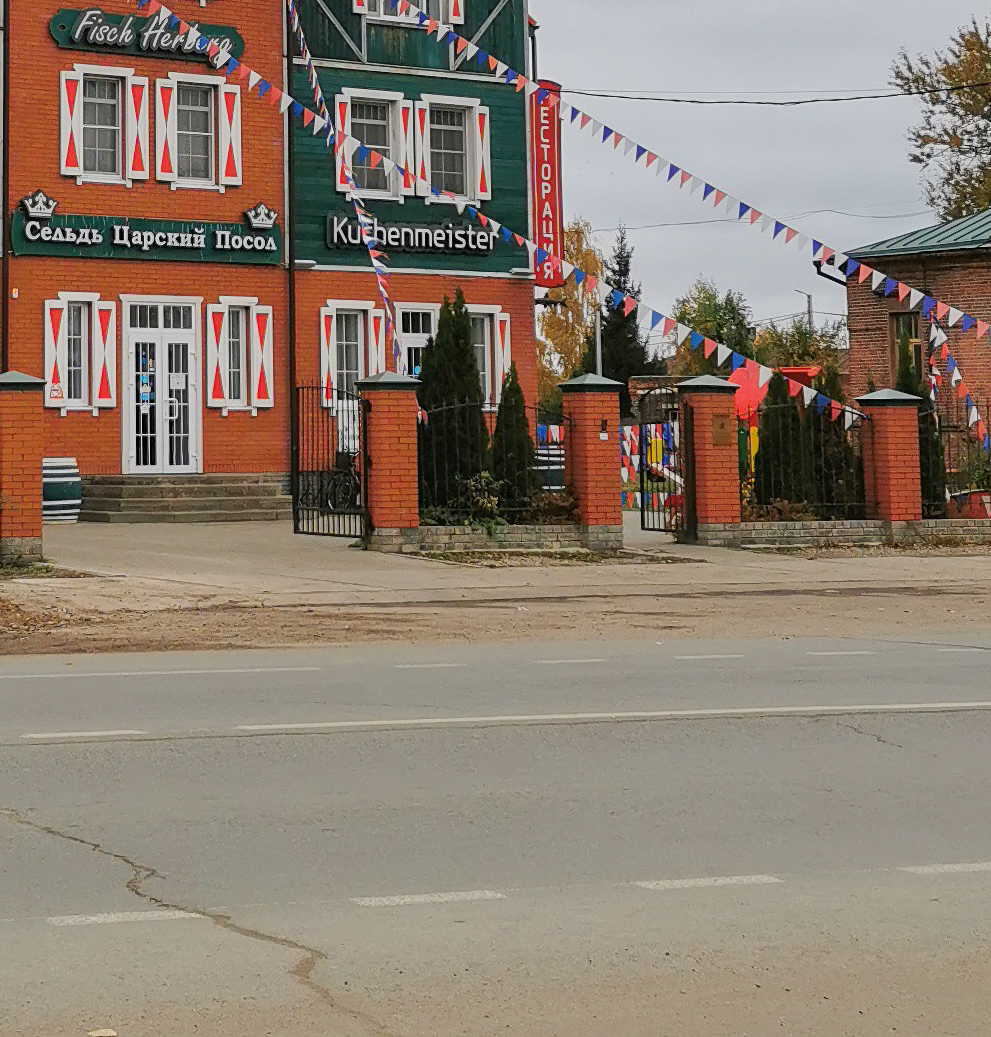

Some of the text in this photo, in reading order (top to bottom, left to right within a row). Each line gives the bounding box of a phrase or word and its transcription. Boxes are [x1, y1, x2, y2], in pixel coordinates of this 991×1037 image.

[74, 10, 134, 44] Fisch
[539, 90, 555, 280] ЕСТОРАЦИЯ
[25, 220, 278, 251] Сельдь Царский Посол
